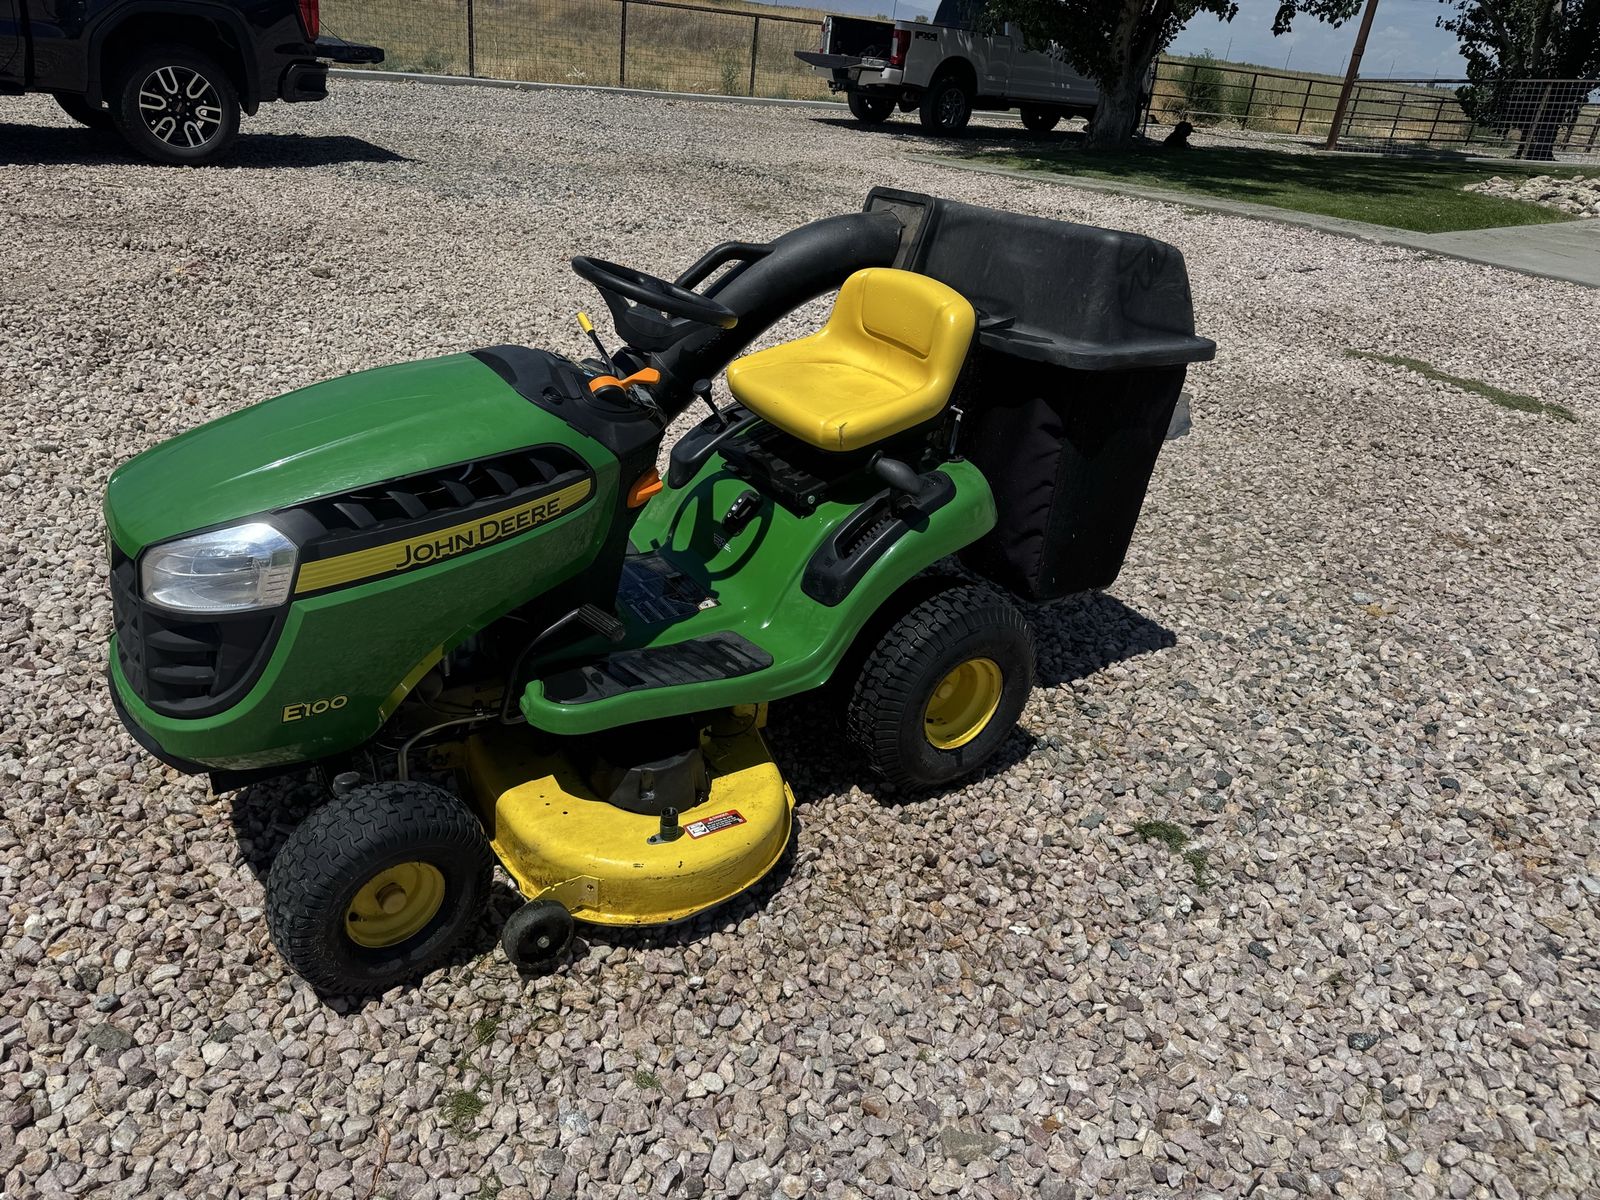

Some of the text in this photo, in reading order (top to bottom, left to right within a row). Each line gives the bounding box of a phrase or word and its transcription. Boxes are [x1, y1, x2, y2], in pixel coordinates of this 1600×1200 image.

[396, 497, 561, 569] JOHN DEERE
[282, 695, 349, 724] E100
